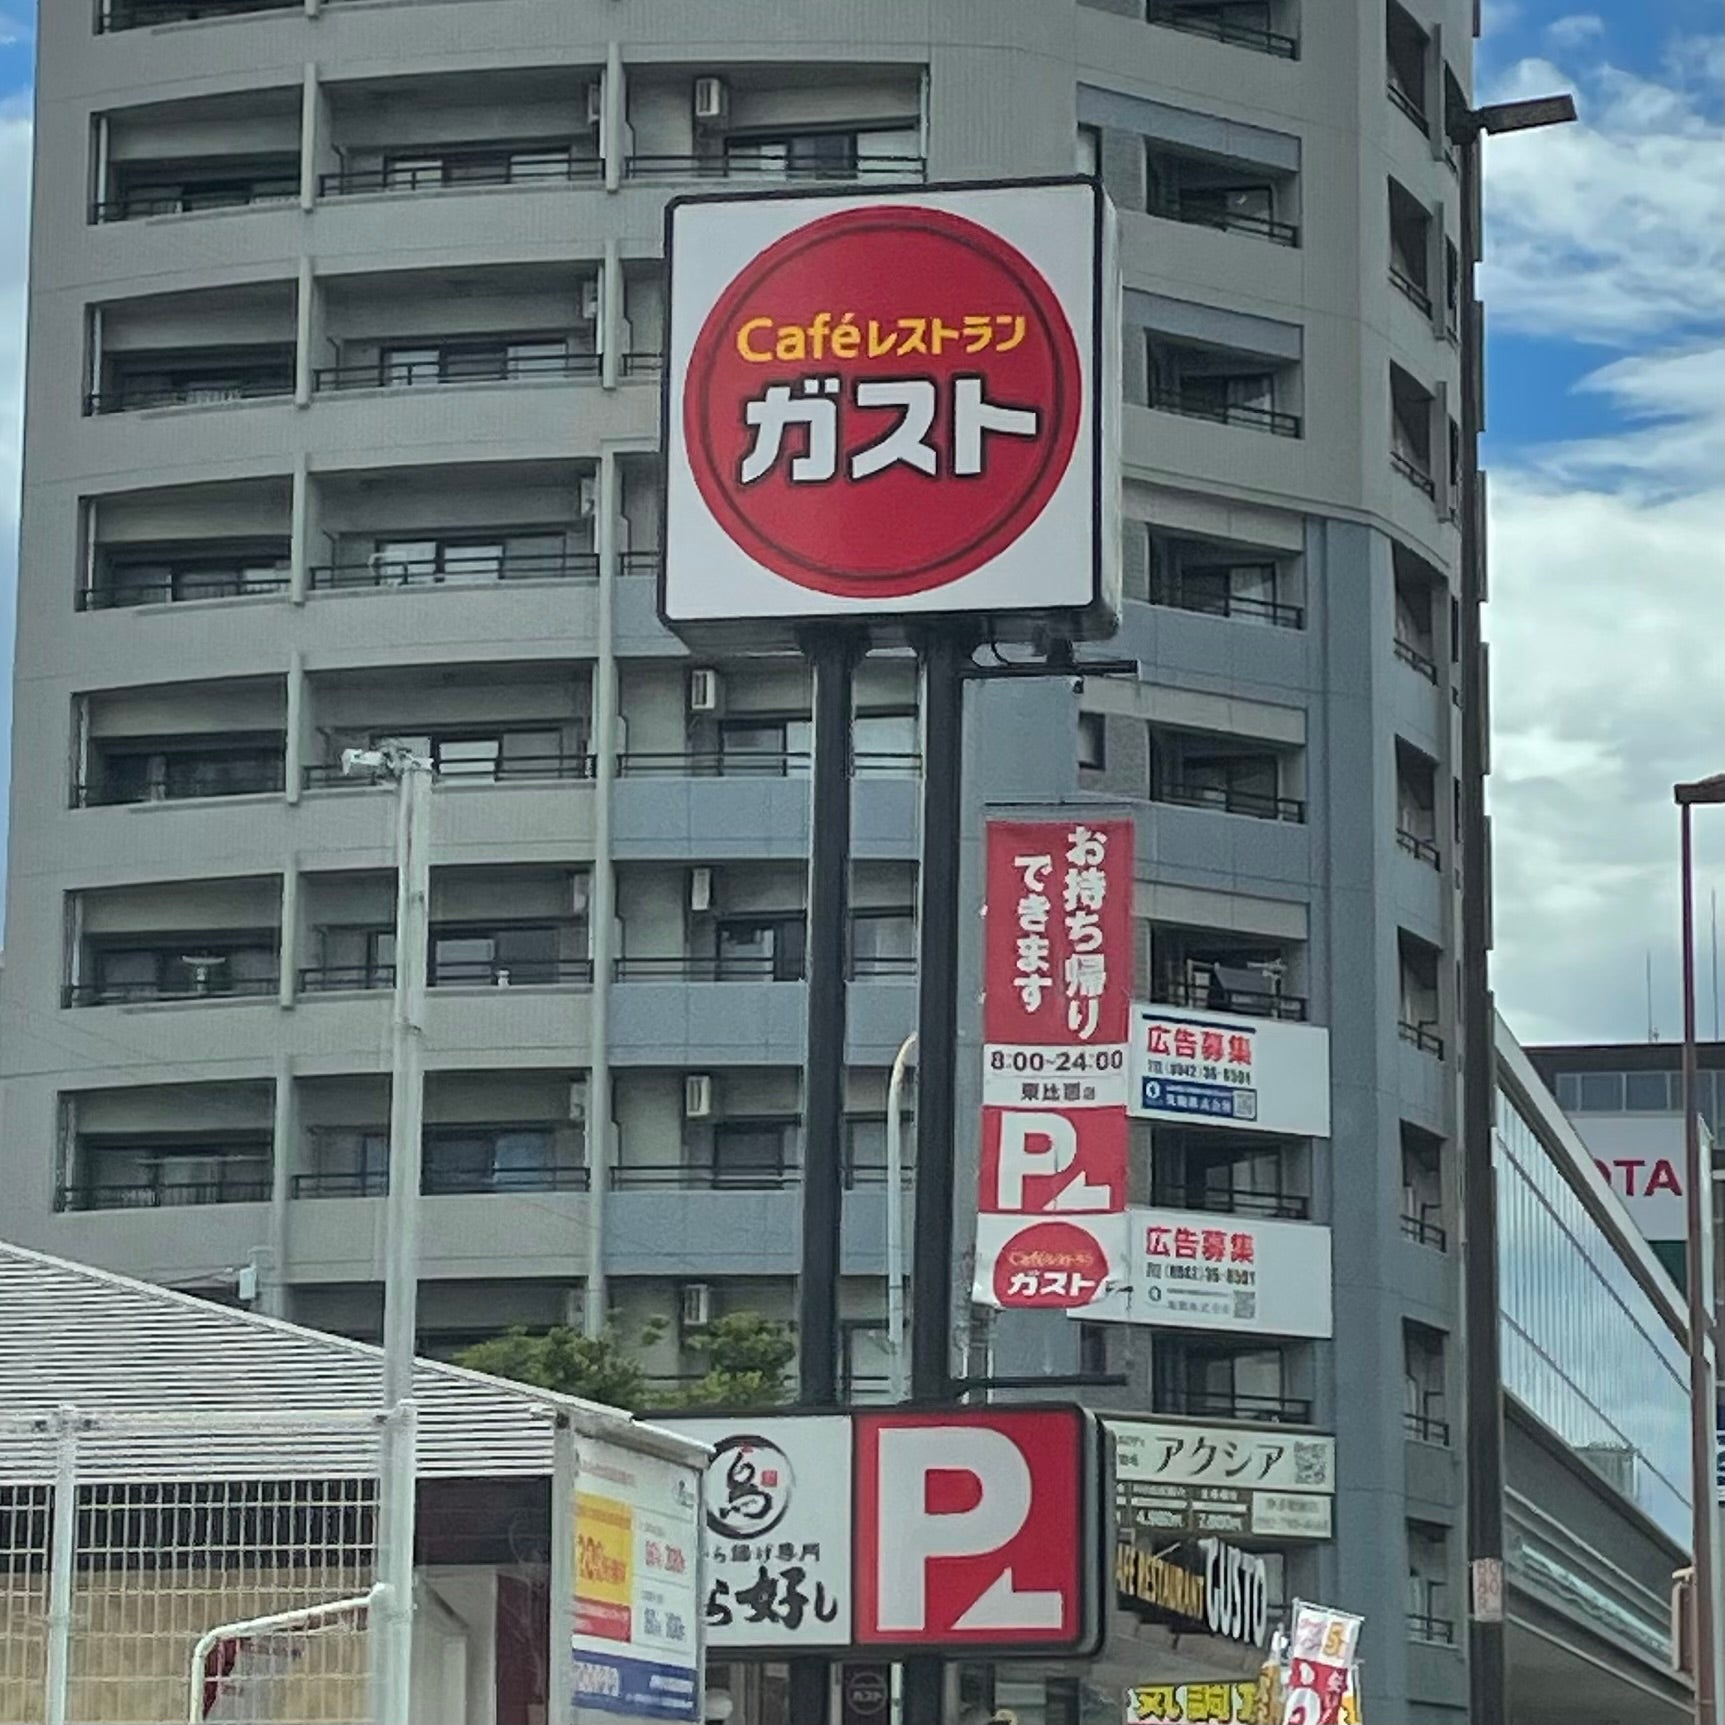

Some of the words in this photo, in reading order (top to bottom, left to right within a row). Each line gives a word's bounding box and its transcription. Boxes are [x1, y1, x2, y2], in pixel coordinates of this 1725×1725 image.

[740, 376, 1039, 485] ガスト
[1013, 854, 1052, 1013] できます
[1063, 826, 1107, 1040] お持ち帰り
[1147, 1024, 1252, 1065] 広告募集
[997, 1111, 1077, 1209] P
[1594, 1158, 1683, 1197] TA
[1007, 1269, 1096, 1297] ガスト
[1145, 1226, 1254, 1264] 広告募集
[1154, 1436, 1285, 1480] アクシア
[876, 1426, 1033, 1632] P
[1203, 1537, 1267, 1648] GUSTO
